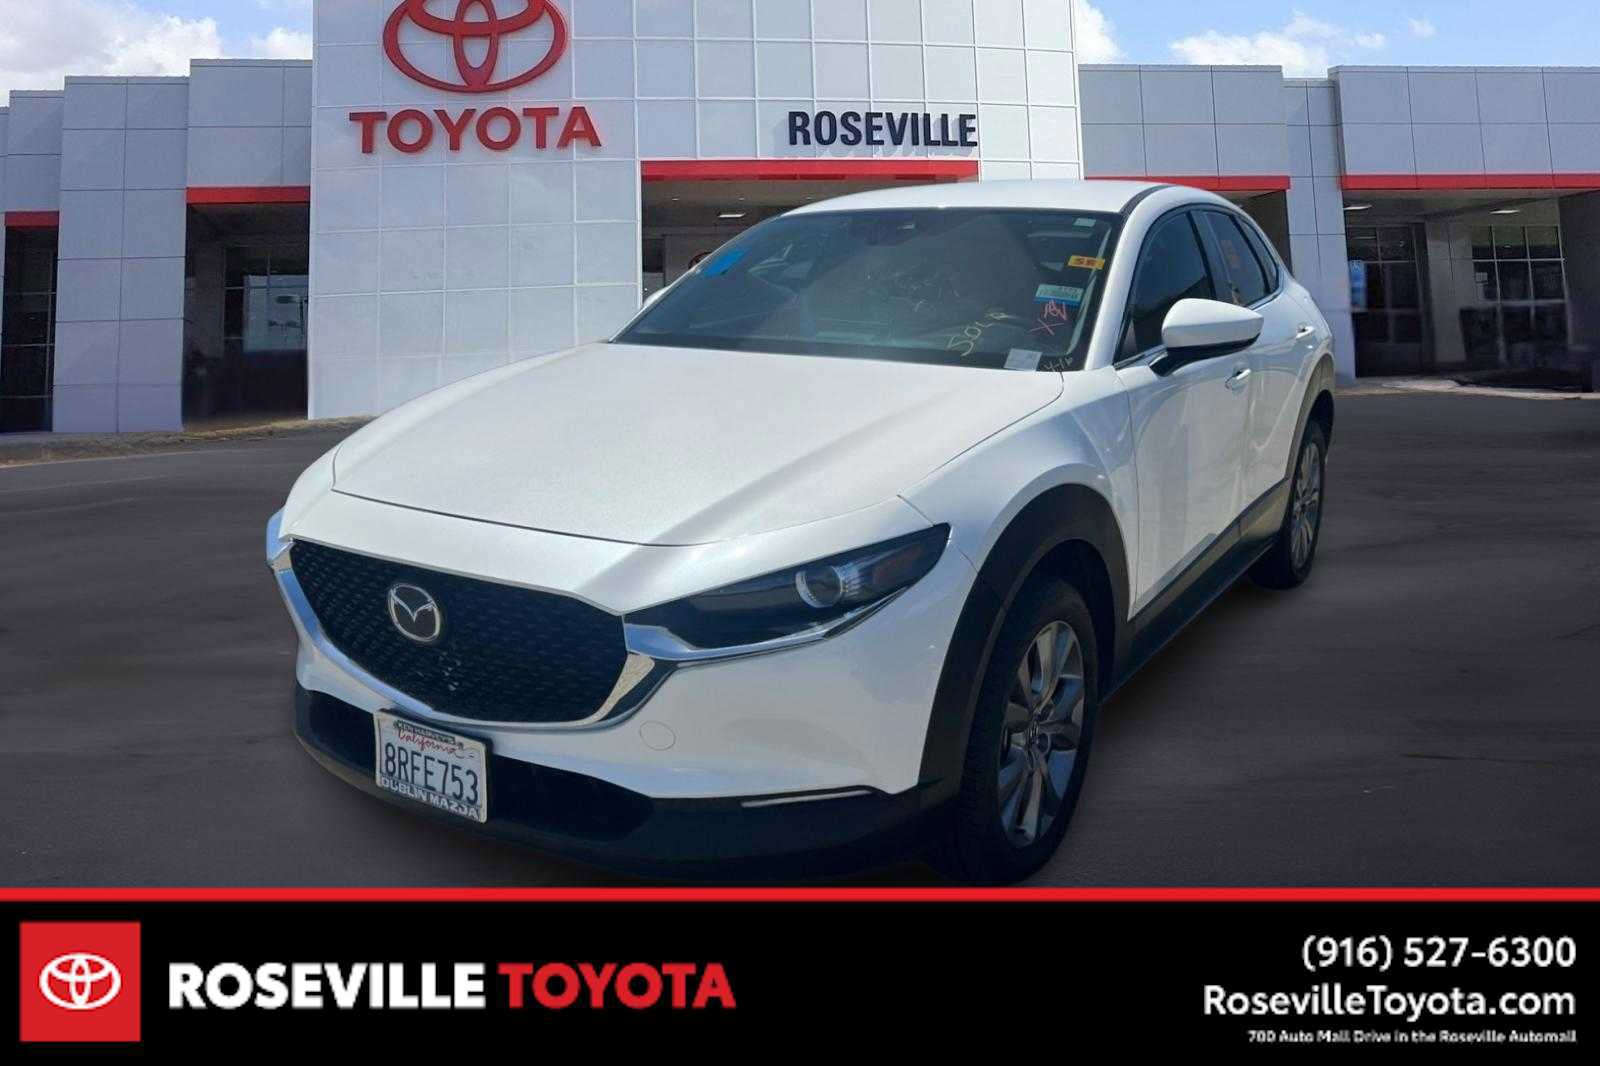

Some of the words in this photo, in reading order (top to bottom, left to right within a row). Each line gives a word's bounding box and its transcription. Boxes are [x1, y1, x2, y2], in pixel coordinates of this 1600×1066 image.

[350, 106, 602, 153] TOYOTA
[788, 110, 978, 147] ROSEVILLE
[384, 742, 478, 806] 8RFE753
